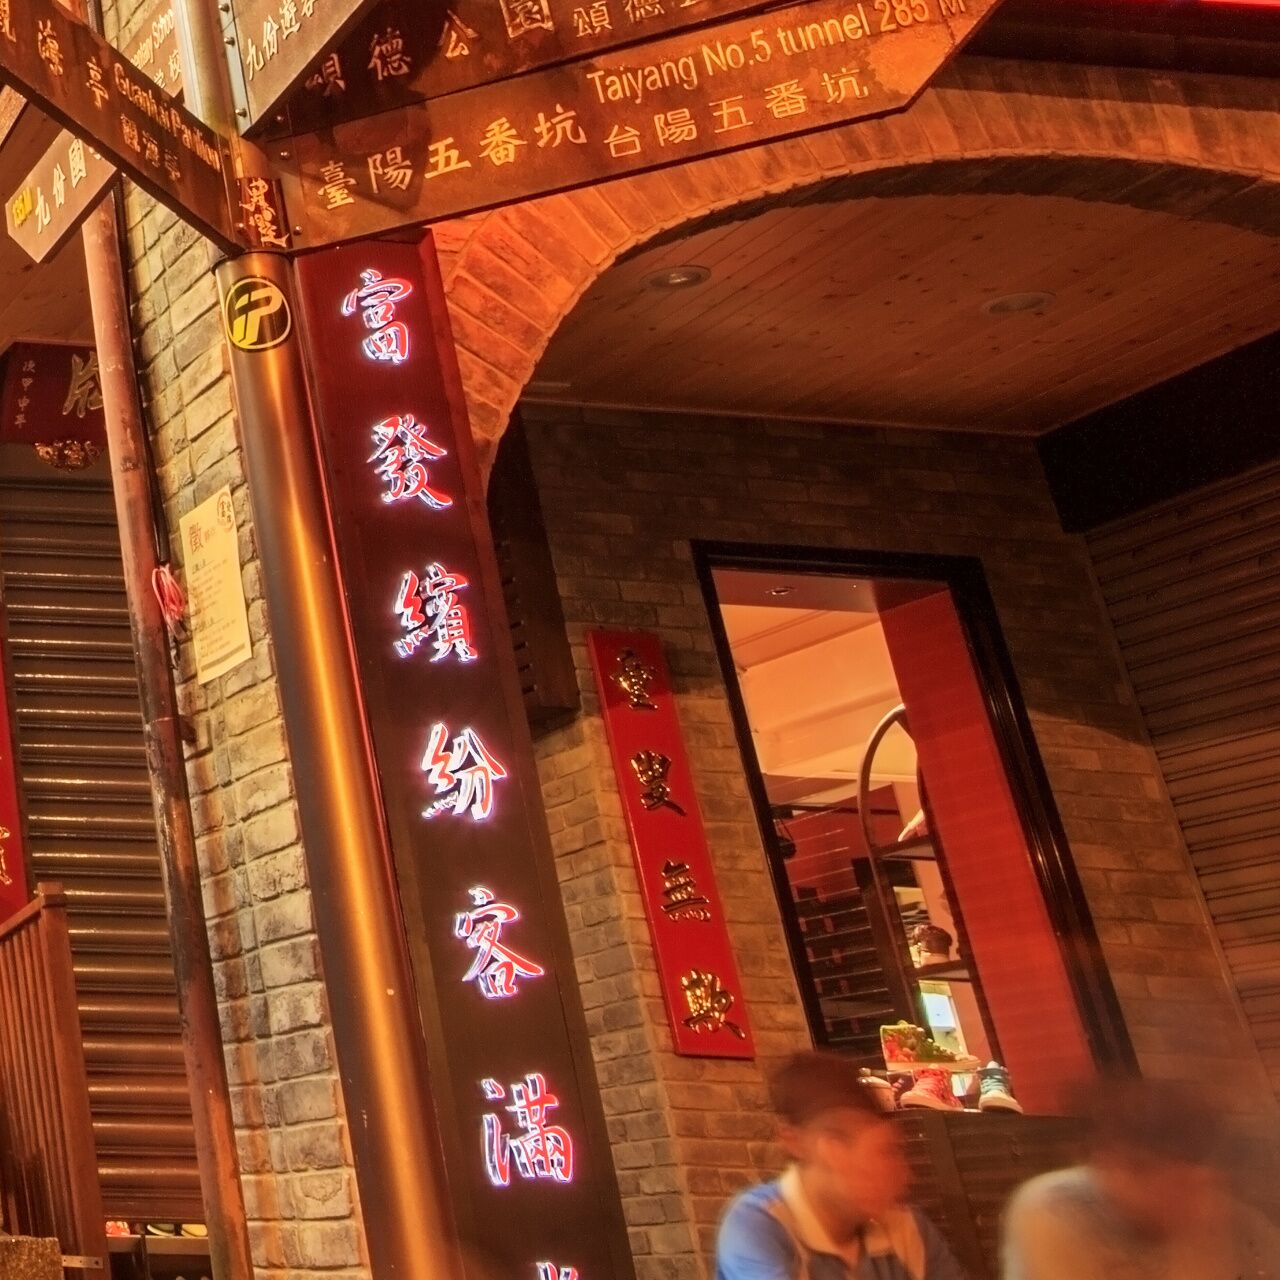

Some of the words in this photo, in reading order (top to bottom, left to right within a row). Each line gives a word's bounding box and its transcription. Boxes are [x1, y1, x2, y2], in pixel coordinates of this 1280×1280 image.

[587, 51, 697, 107] Taiyang
[703, 32, 772, 78] No.5
[777, 3, 871, 56] tunnel
[315, 102, 590, 210] 臺陽五番坑
[602, 65, 871, 158] 台陽五番坑
[342, 268, 583, 1280] 富發繽紛客滿
